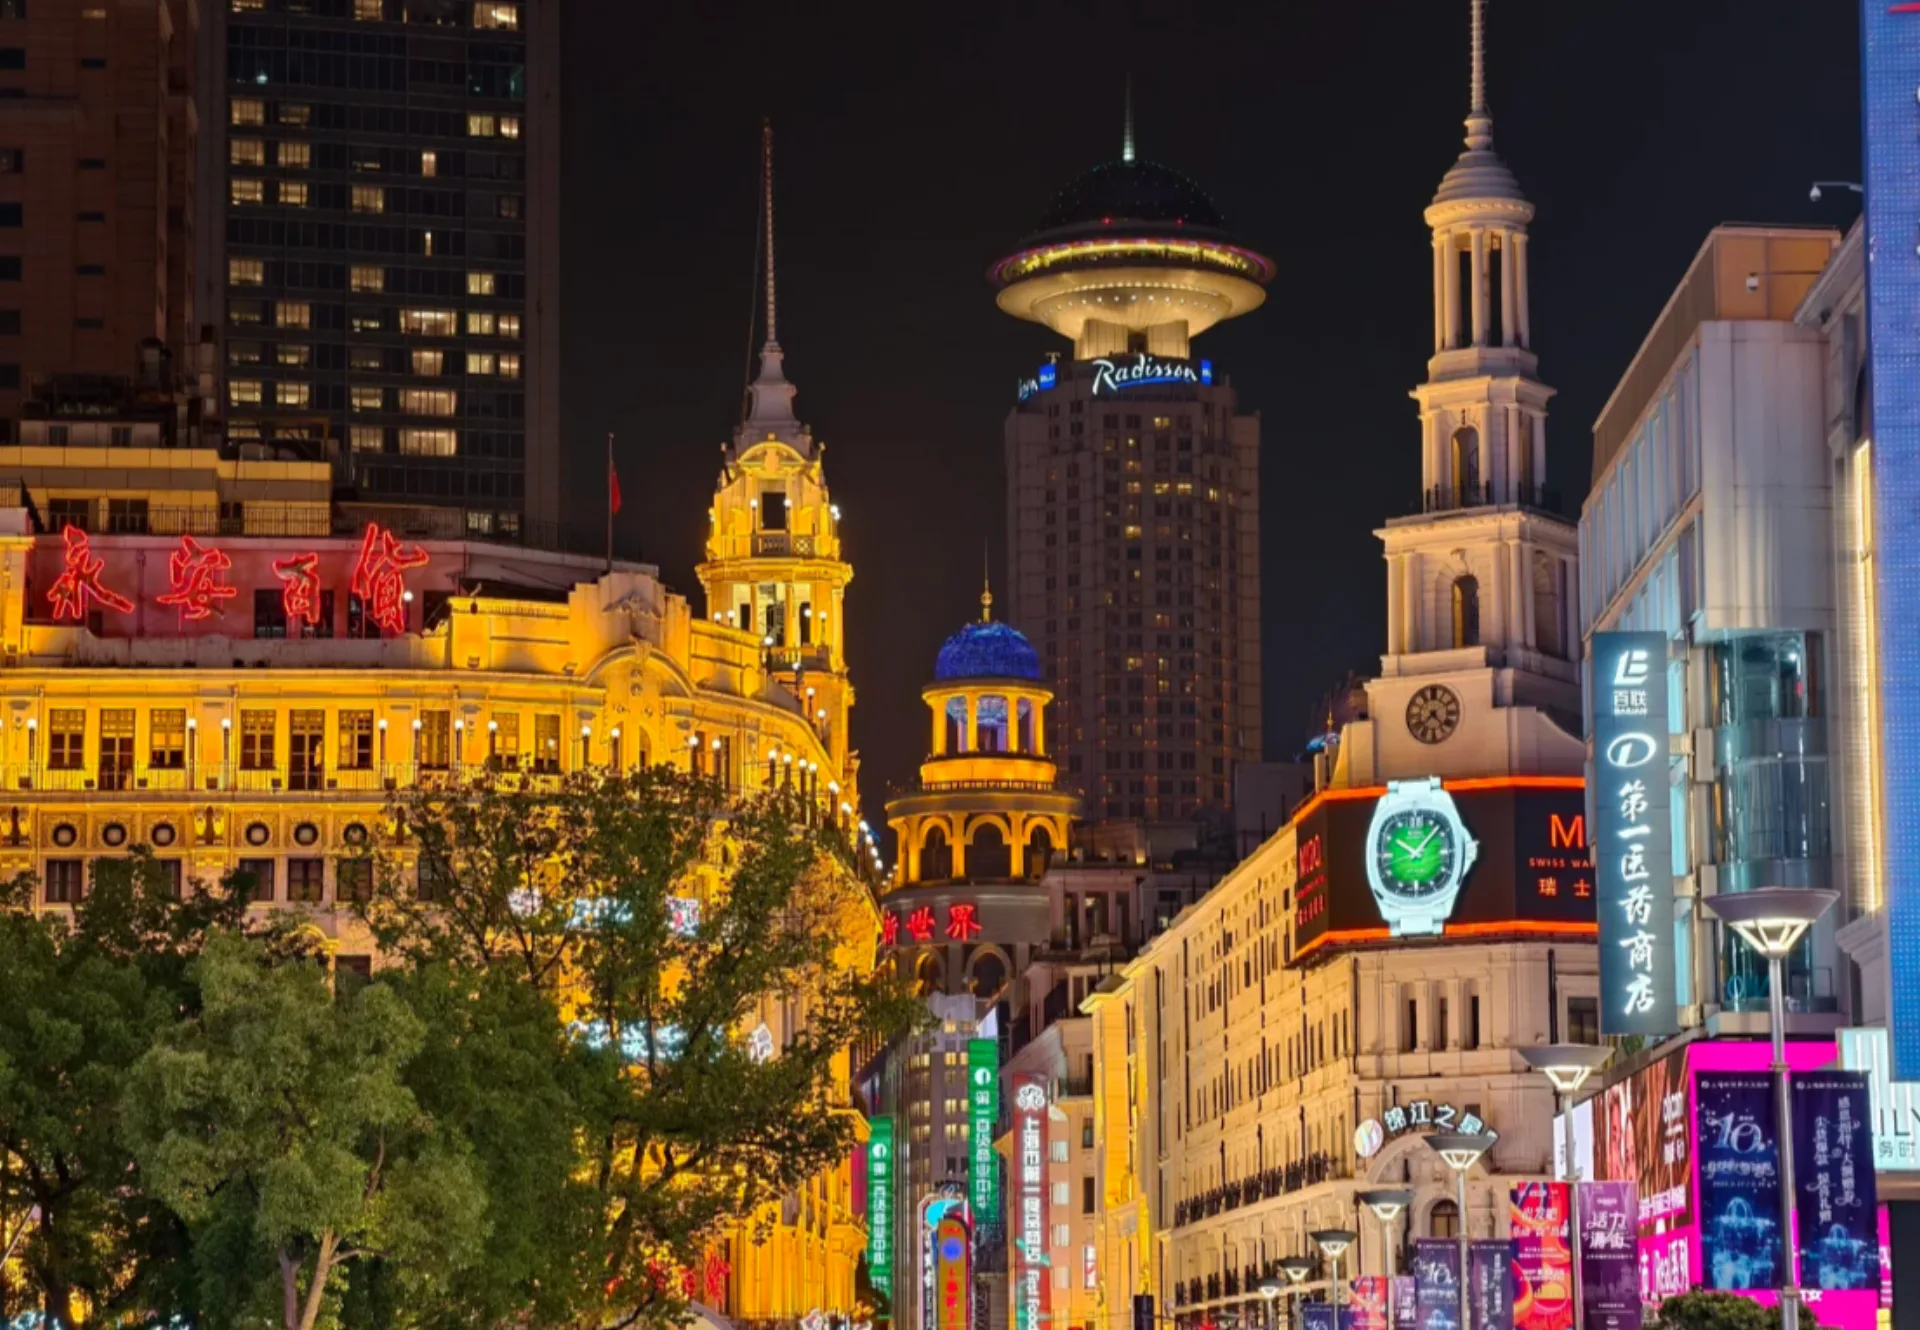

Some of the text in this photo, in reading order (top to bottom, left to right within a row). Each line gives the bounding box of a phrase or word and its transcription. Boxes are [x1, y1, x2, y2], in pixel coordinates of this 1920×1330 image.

[1092, 353, 1198, 395] Radisson
[1528, 857, 1565, 868] SWISS
[1539, 876, 1591, 897] 瑞士
[1616, 779, 1657, 1016] 第一医药商店
[1712, 1112, 1763, 1154] 10
